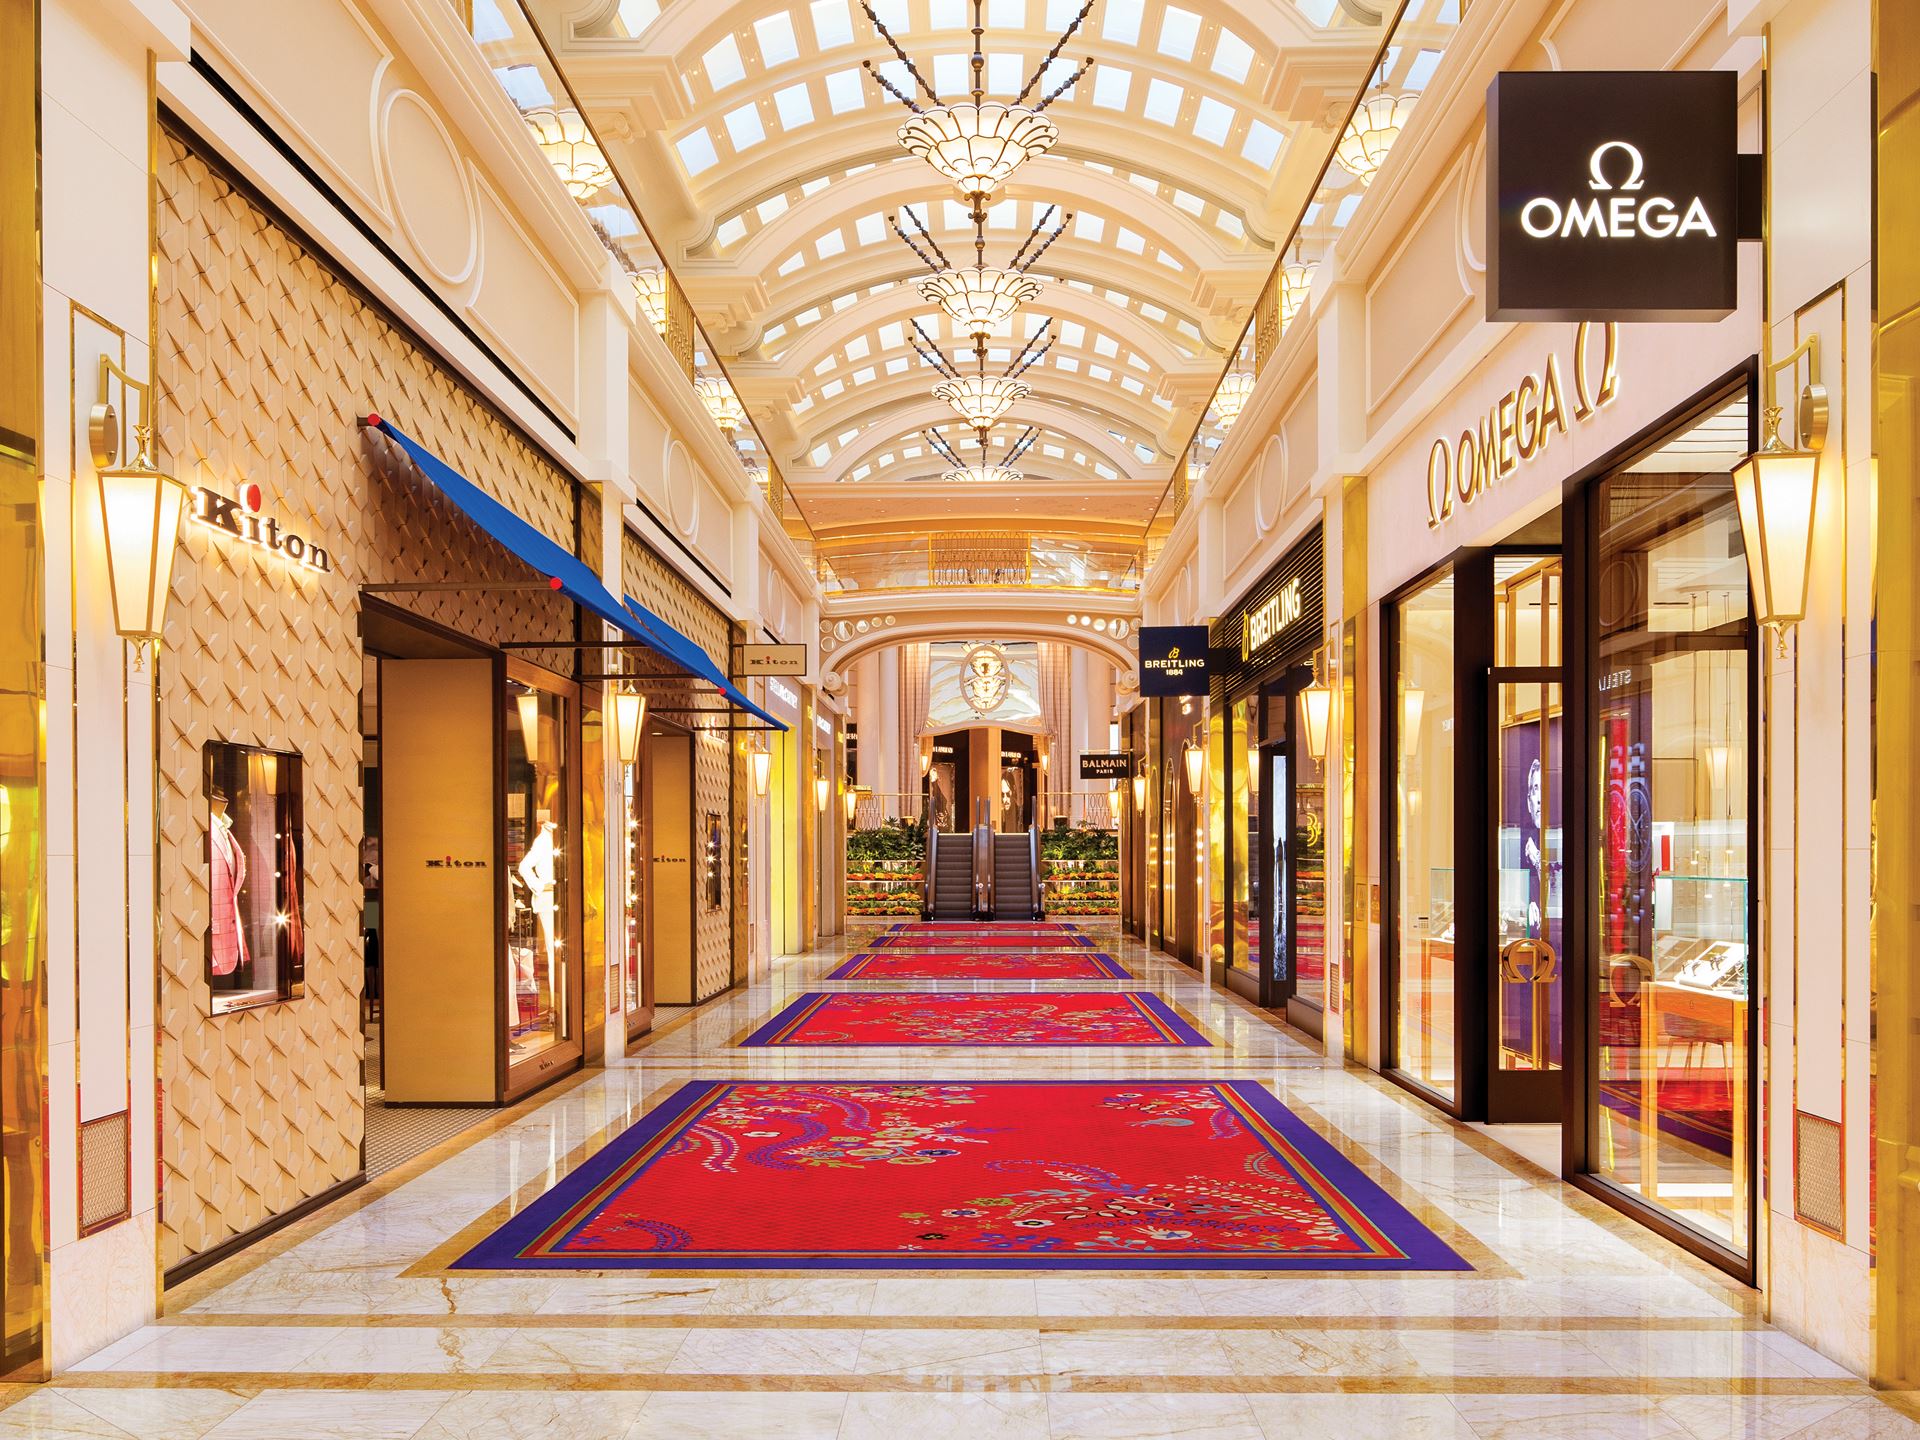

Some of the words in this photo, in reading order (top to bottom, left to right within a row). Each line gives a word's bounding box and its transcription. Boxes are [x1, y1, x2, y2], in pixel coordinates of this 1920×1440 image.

[1520, 196, 1717, 239] OMEGA
[1456, 352, 1568, 506] OMEGA
[191, 483, 332, 574] Kiton
[1250, 577, 1301, 651] BREITLING
[749, 655, 799, 665] Kiton
[1144, 659, 1205, 668] BREITLING
[1082, 759, 1127, 768] BALMAIN
[425, 855, 487, 868] Kiton
